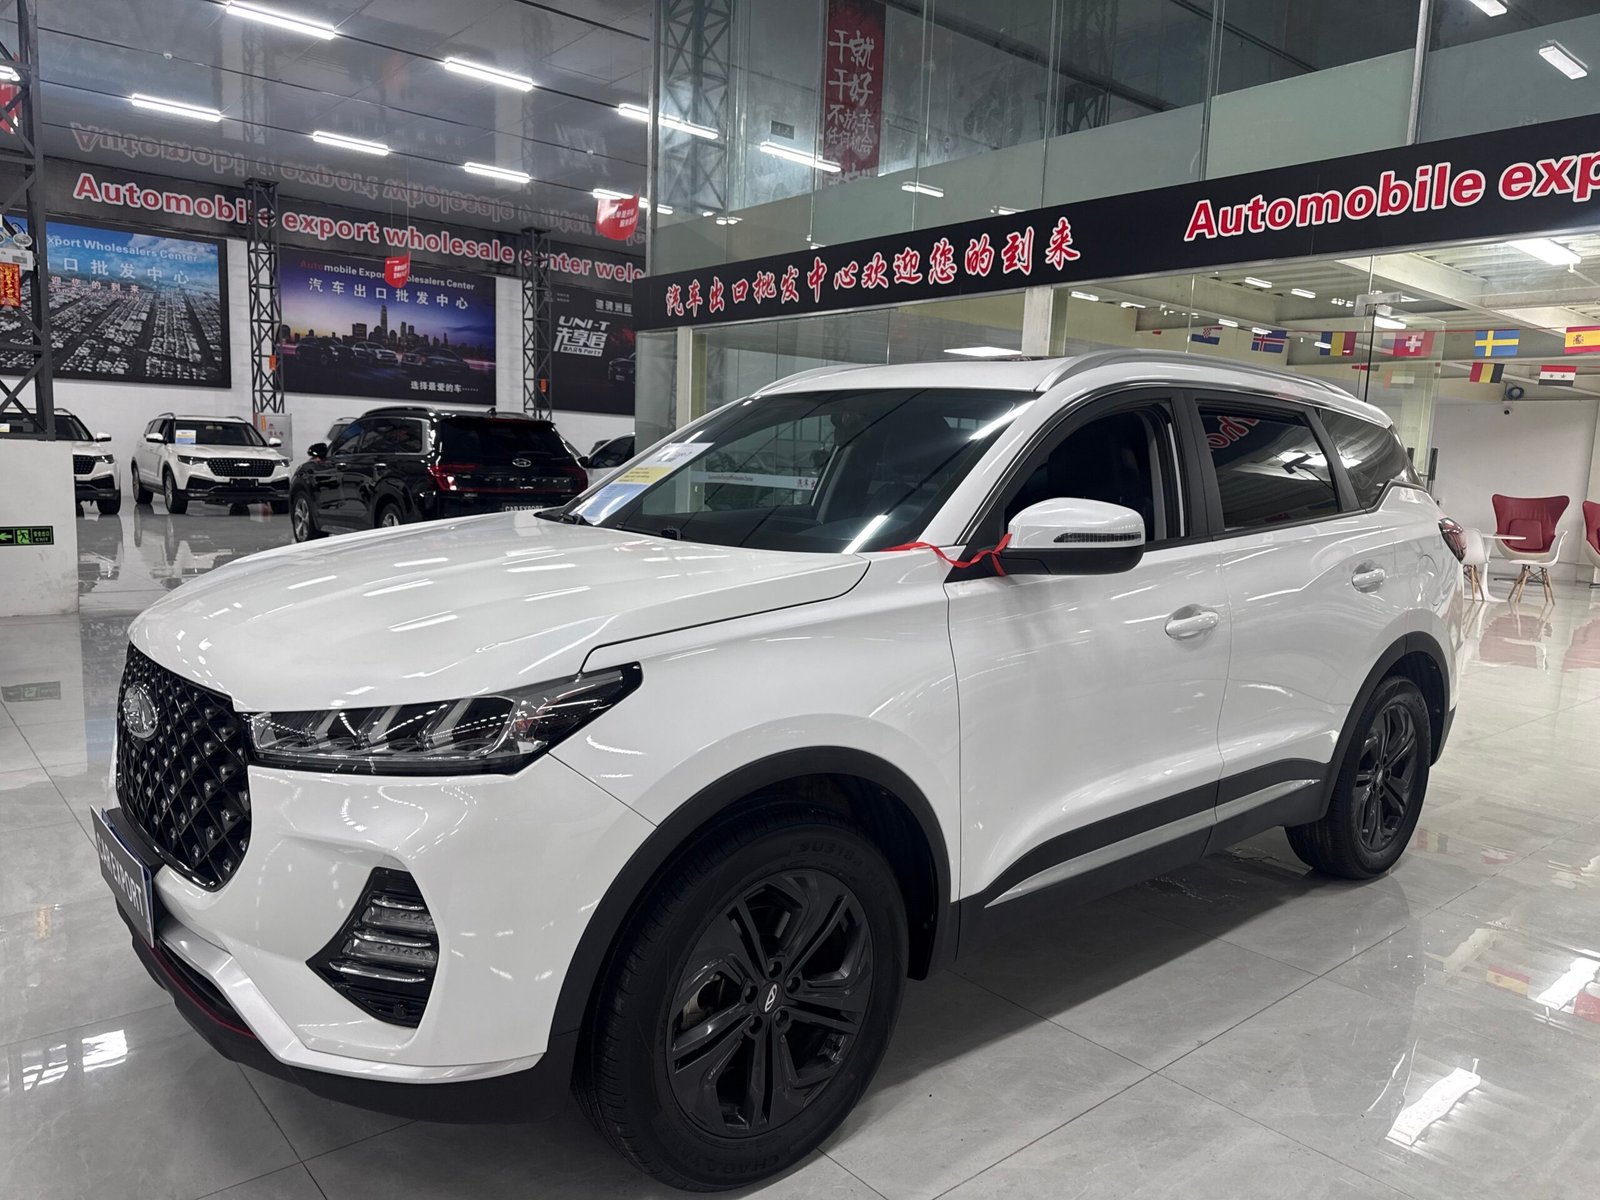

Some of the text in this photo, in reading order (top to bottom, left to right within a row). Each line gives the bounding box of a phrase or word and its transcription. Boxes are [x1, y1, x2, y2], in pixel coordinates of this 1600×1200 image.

[1184, 161, 1486, 242] Automobile
[47, 236, 198, 262] xport Wholesalers Center
[282, 210, 380, 246] export
[384, 225, 515, 265] wholesale
[47, 255, 190, 285] 口批发中心
[301, 260, 357, 275] Automobile
[358, 269, 386, 280] Expor
[446, 279, 475, 291] Center
[666, 216, 1081, 318] 汽车出口批发中心欢迎您的到来
[50, 275, 140, 294] 迎您的到来
[309, 277, 468, 310] 汽车出口批发中心
[558, 315, 611, 331] UNI-T
